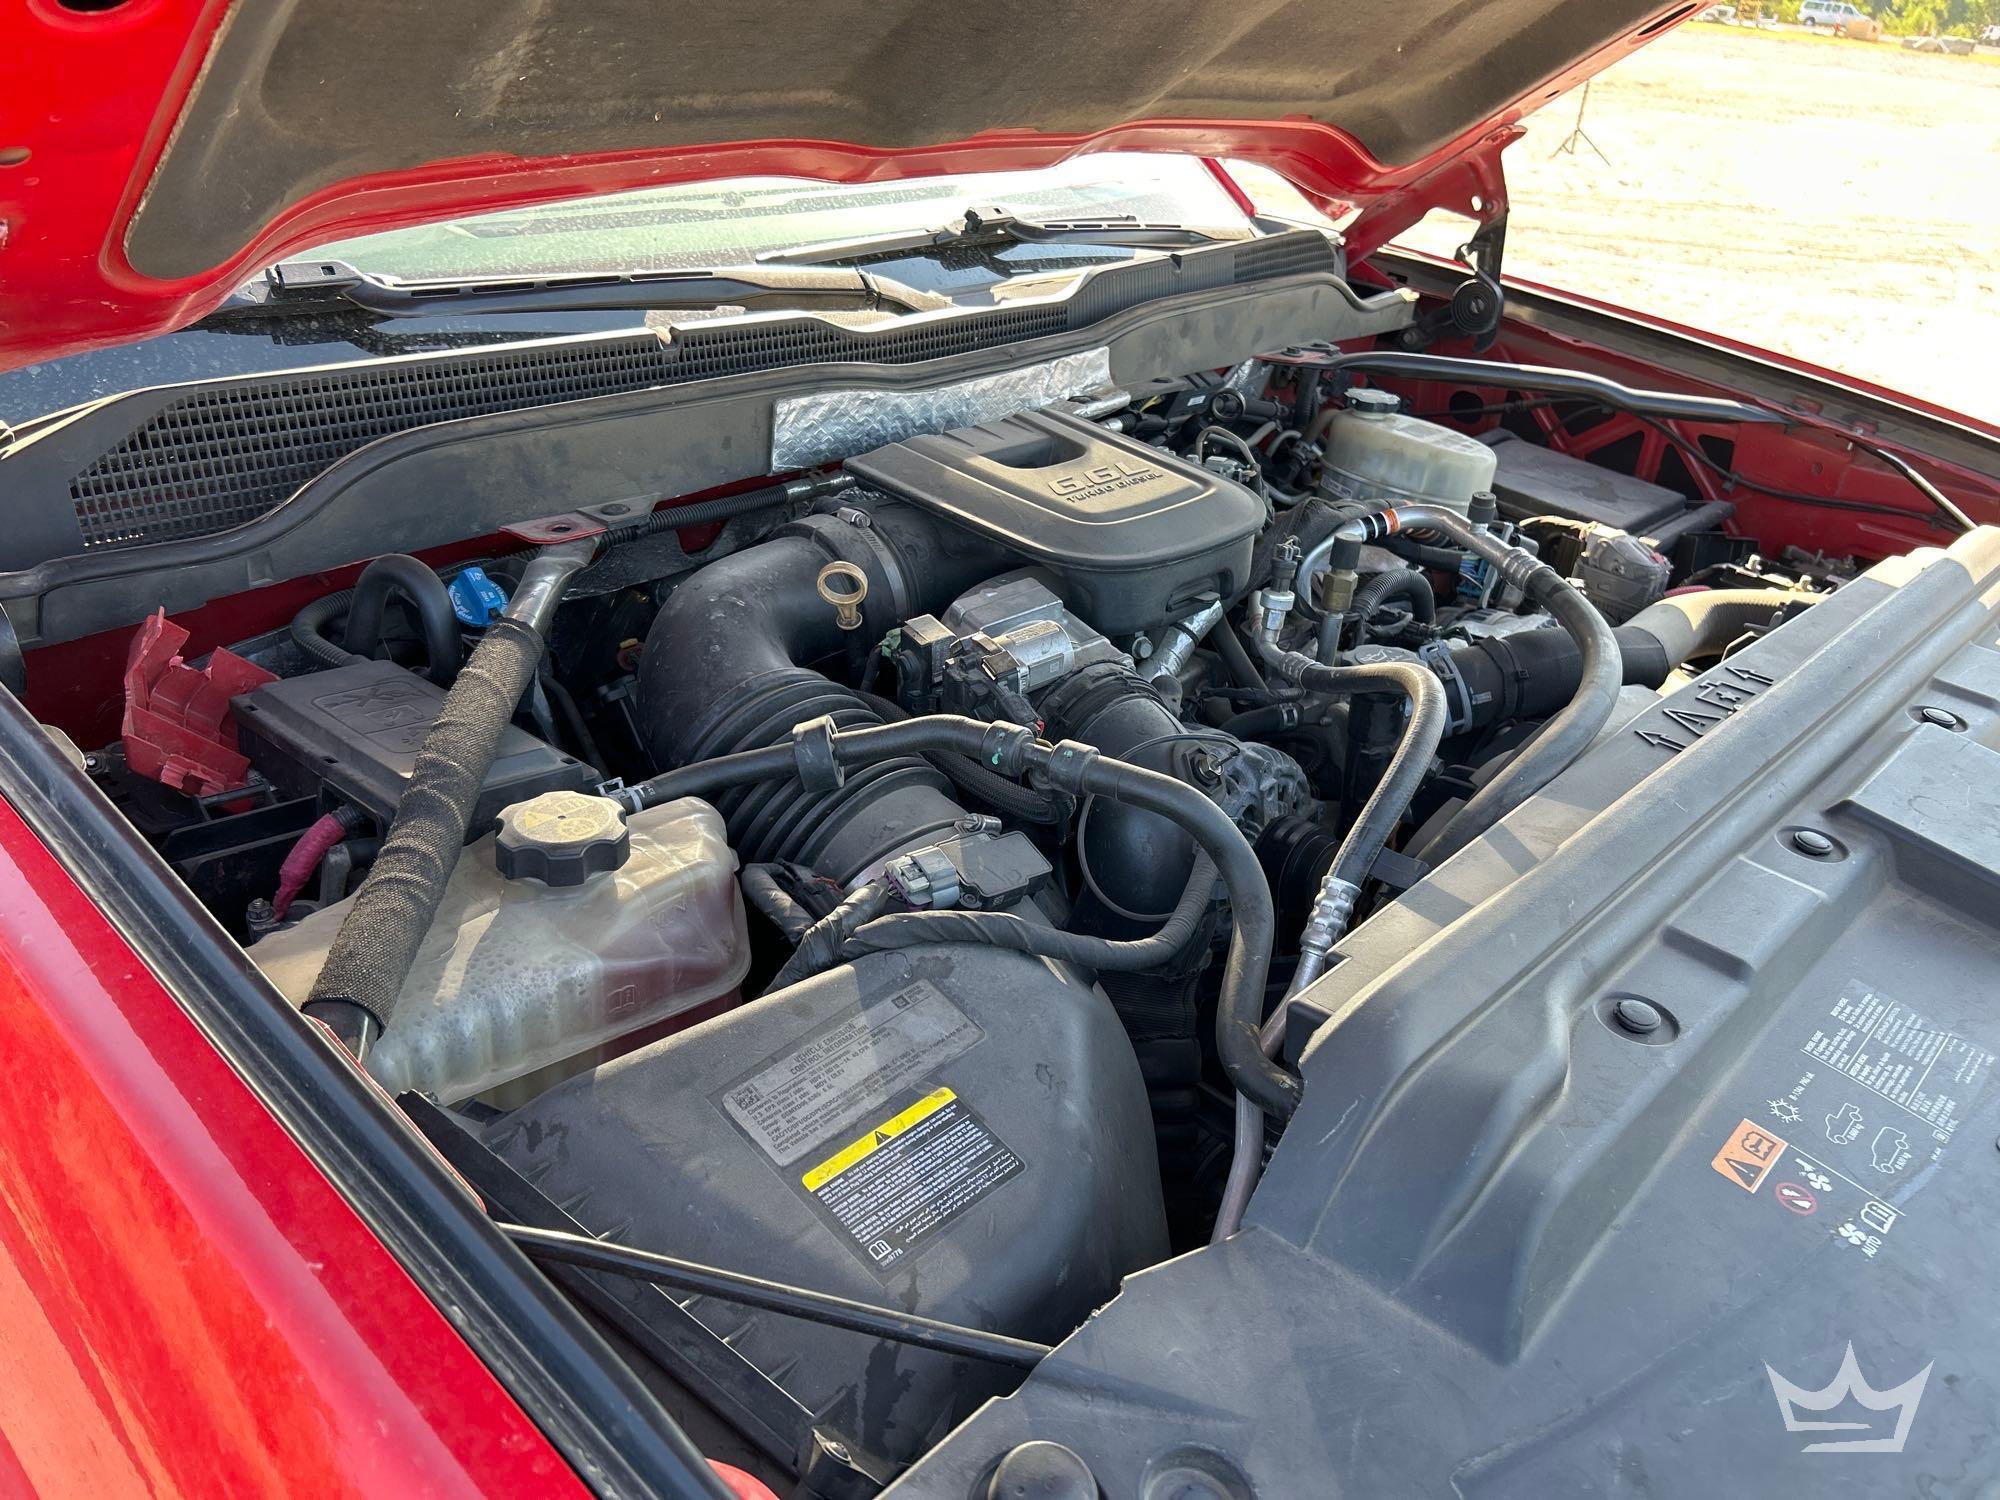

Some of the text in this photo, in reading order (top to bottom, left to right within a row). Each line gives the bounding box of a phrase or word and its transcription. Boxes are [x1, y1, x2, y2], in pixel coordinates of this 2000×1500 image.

[1048, 462, 1152, 496] 6.6L
[1066, 473, 1163, 503] TURBO DIESEL
[789, 1024, 870, 1075] CONTROL INFORMATION
[792, 1023, 857, 1063] VEHICLE EMISSION
[1862, 1235, 1882, 1258] AUTO
